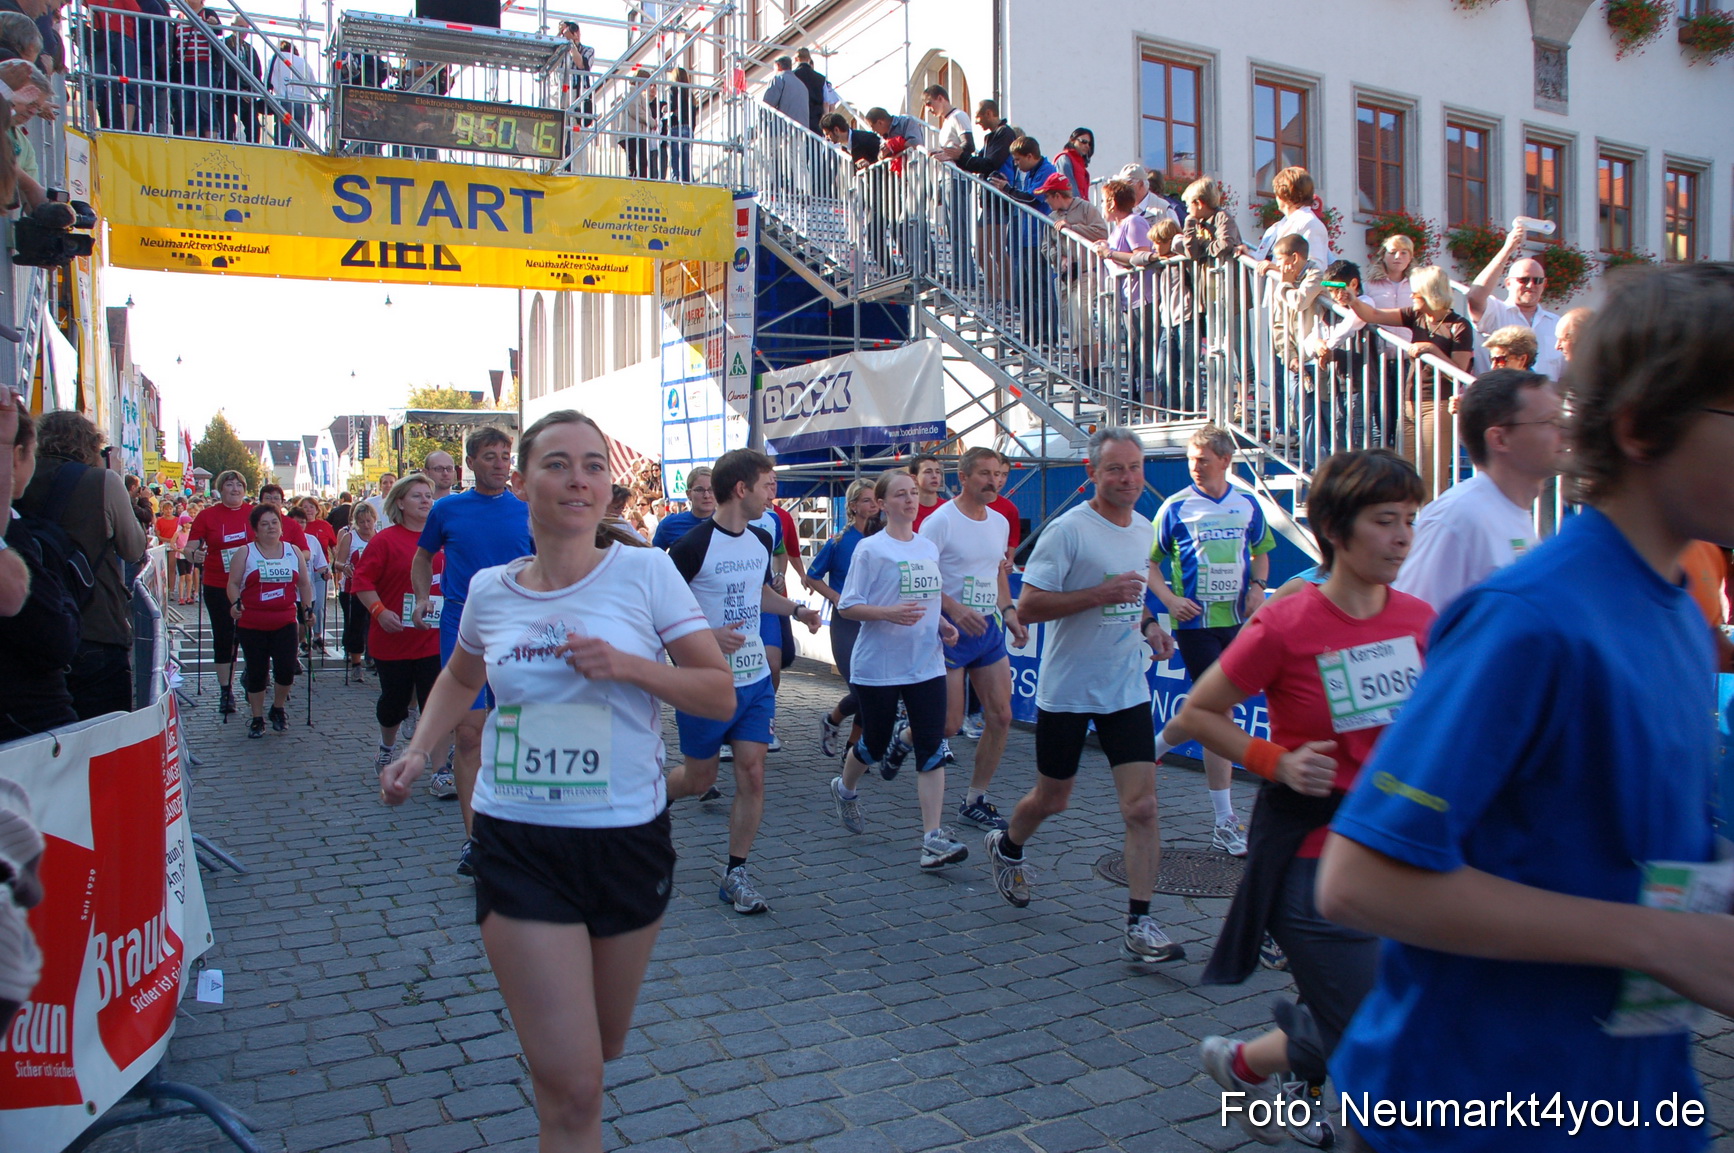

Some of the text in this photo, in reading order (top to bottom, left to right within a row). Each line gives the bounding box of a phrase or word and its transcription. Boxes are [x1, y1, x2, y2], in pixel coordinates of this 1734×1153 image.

[415, 97, 554, 120] Elektronische Sportstätteneinrichtungen
[140, 184, 292, 208] Neumarkter Stadtlauf
[332, 174, 545, 234] START
[582, 218, 702, 237] Neumarkter Stadtlauf
[139, 236, 270, 255] Neumarkter Stadtlauf
[525, 259, 585, 271] Neumarkter
[763, 371, 853, 424] BOCK
[1198, 527, 1245, 542] BOCK
[269, 568, 290, 576] 5062
[715, 558, 763, 575] GERMANY
[910, 563, 924, 571] Silke
[1210, 567, 1234, 575] Andreas
[914, 576, 939, 589] 5071
[1211, 580, 1238, 591] 5092
[974, 593, 996, 604] 5127
[736, 653, 763, 669] 5072
[1360, 666, 1419, 701] 5086
[524, 748, 600, 775] 5179
[85, 868, 97, 895] 1929
[130, 982, 161, 1014] Sicher
[15, 1061, 43, 1078] Sicher
[43, 1062, 52, 1077] ist
